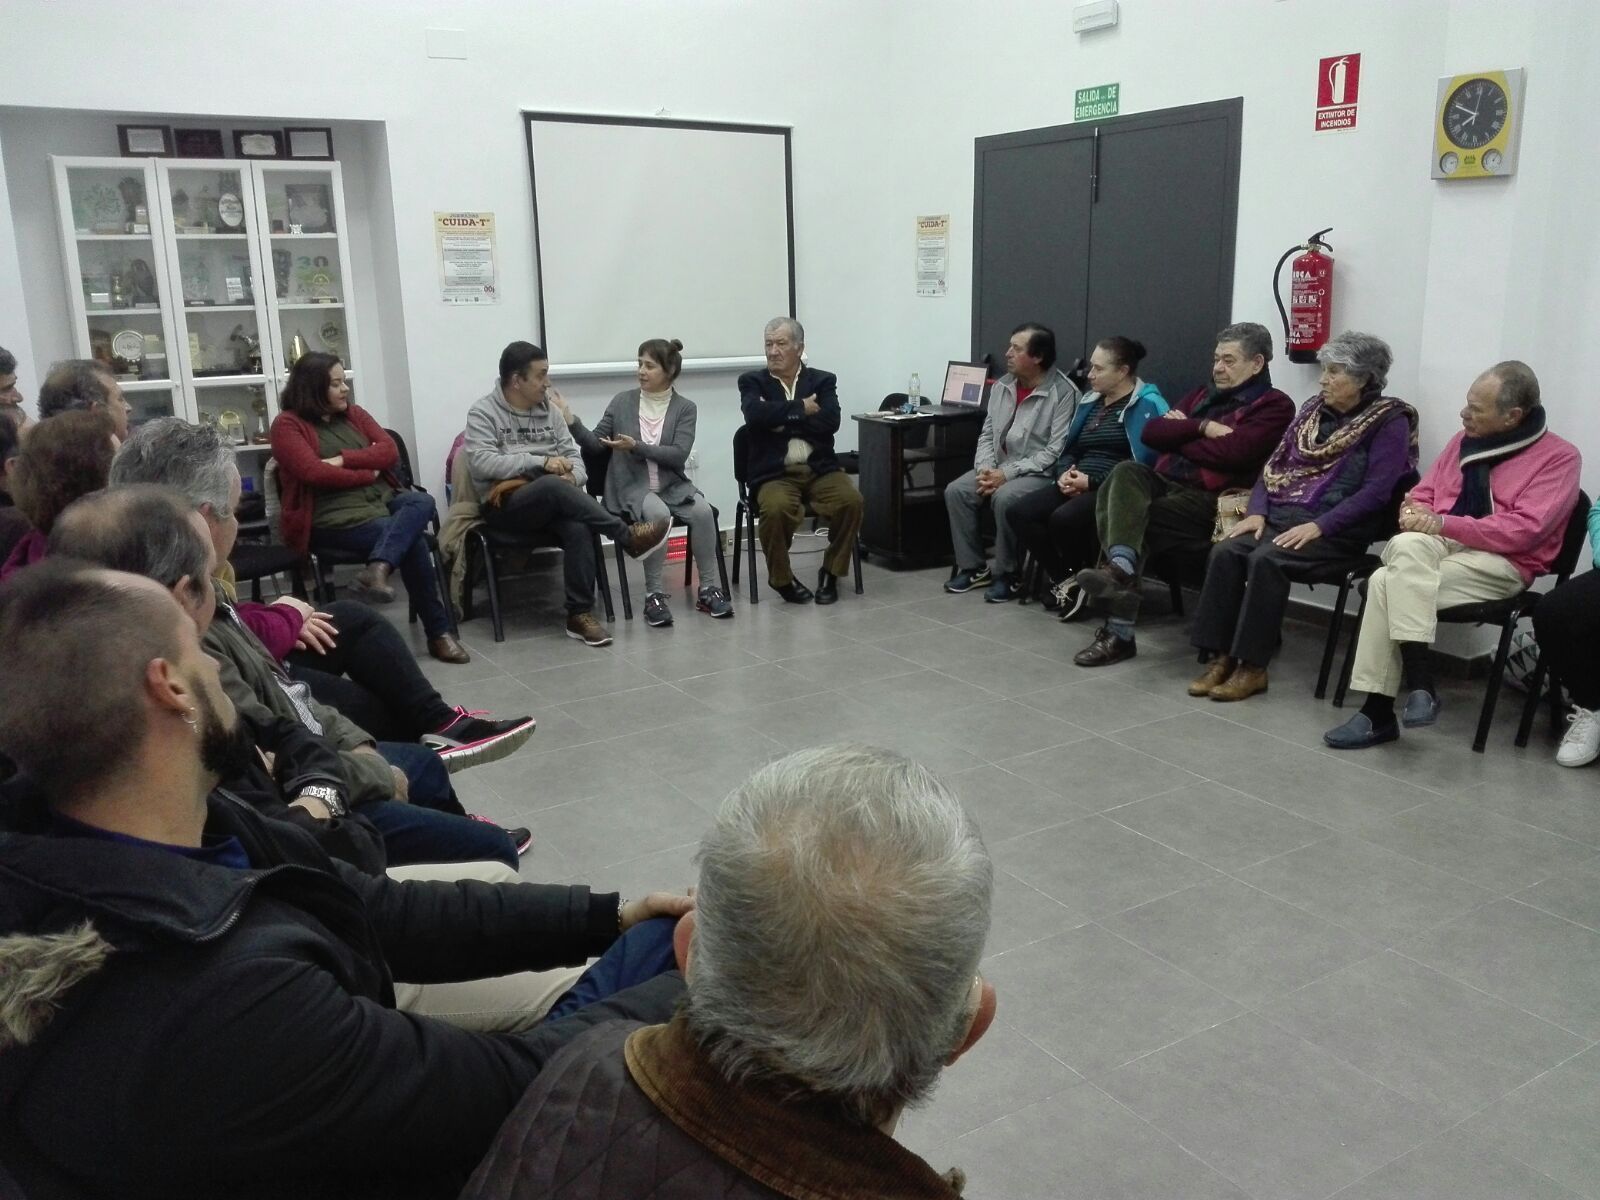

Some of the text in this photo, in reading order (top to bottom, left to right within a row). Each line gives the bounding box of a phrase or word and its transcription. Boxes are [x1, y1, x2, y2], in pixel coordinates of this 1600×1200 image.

[1078, 86, 1117, 104] SALIDA DE
[1075, 101, 1118, 118] EMERGENCIA
[1318, 108, 1356, 120] EXTINTOR DE
[1320, 118, 1352, 128] INCENDIOS
